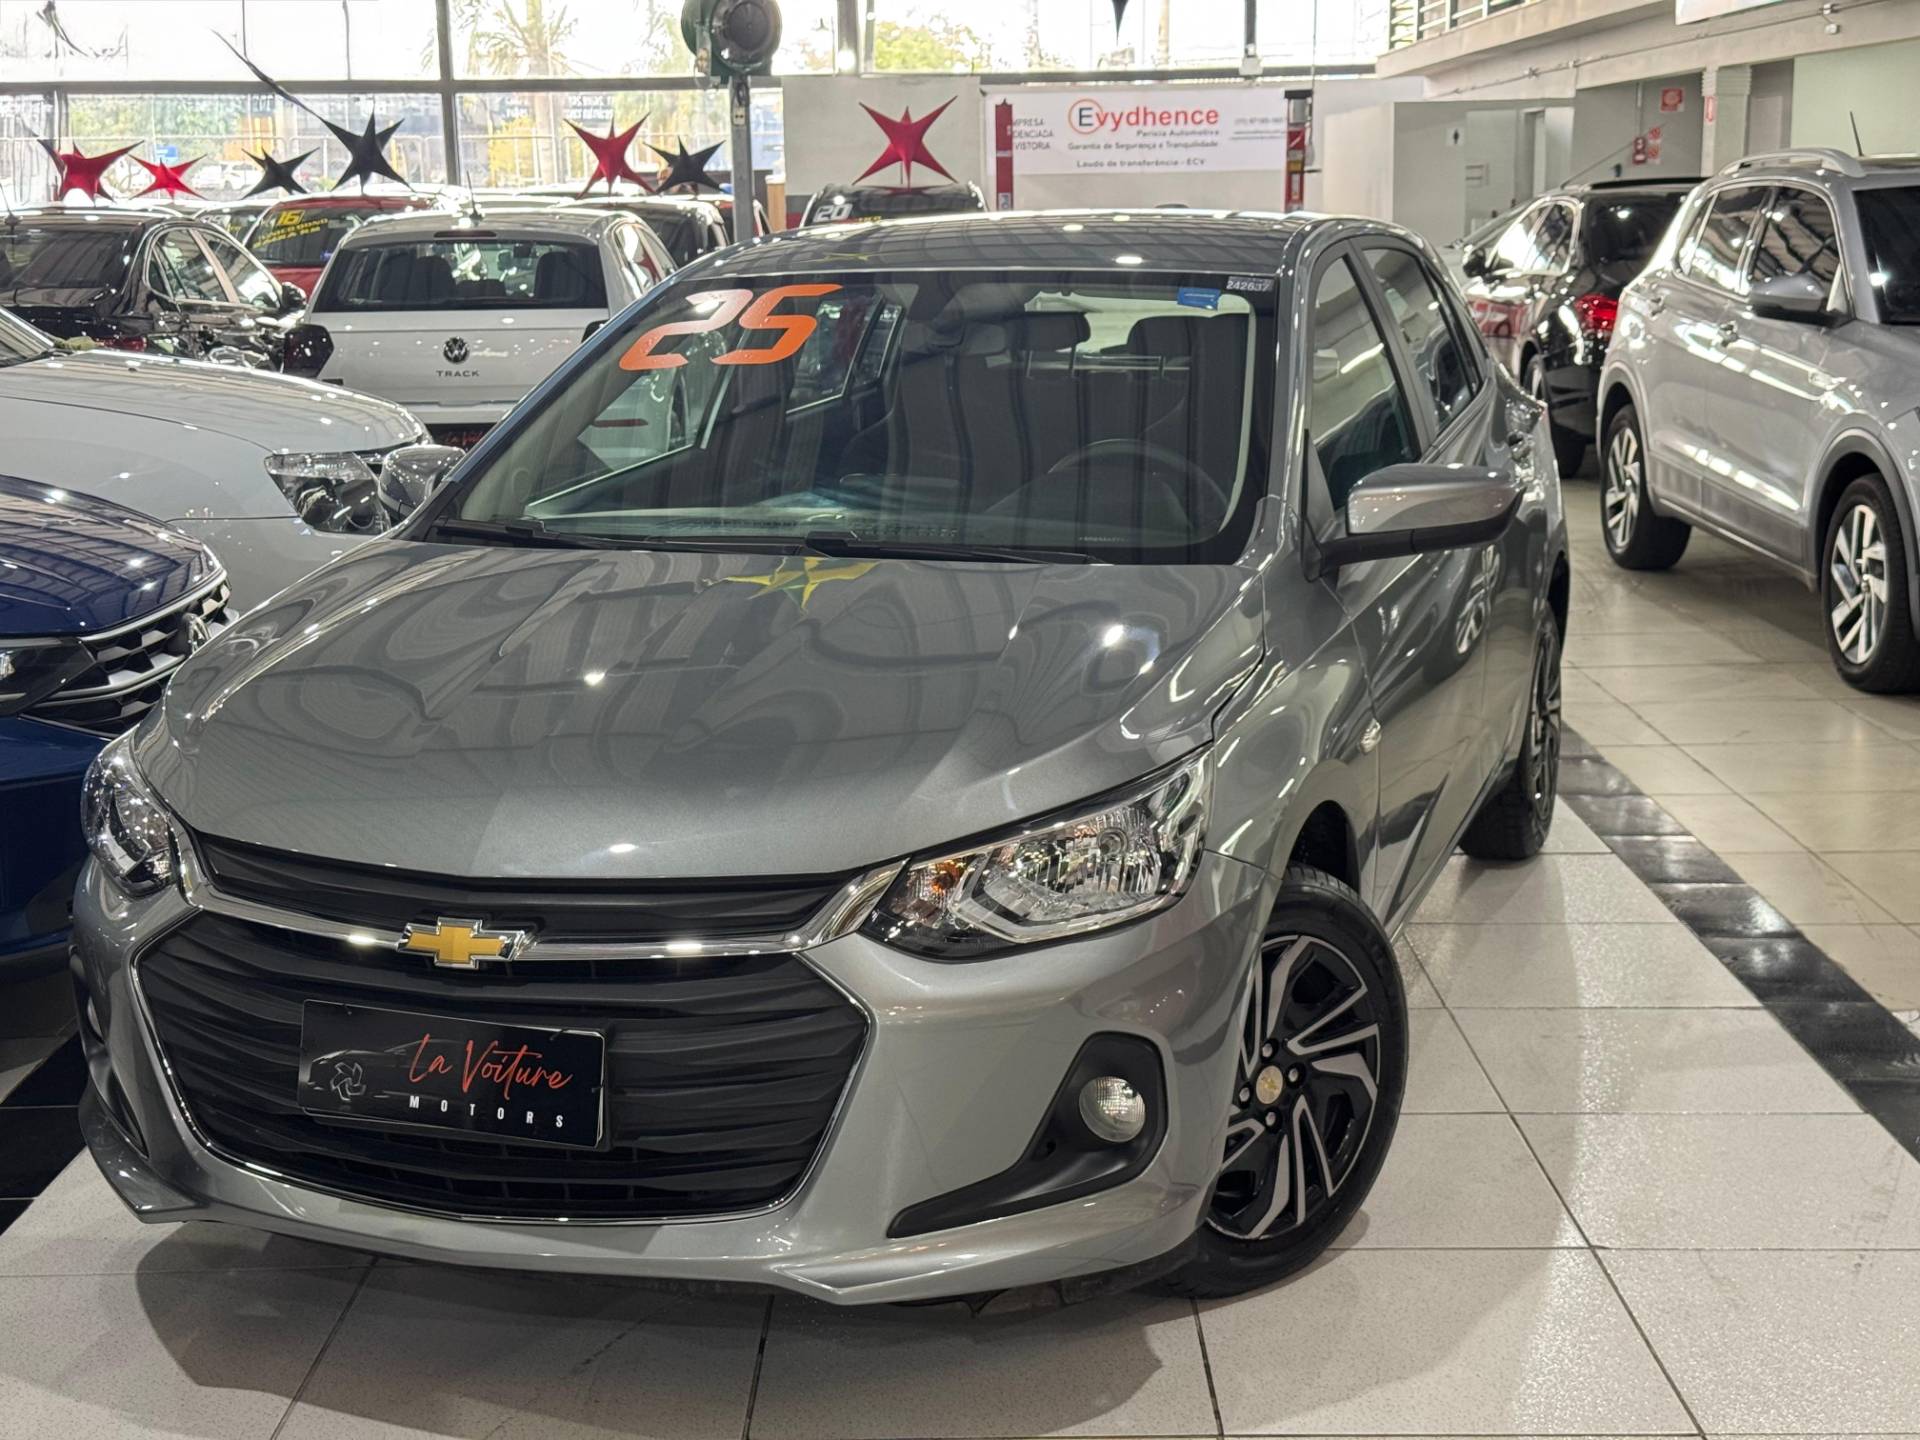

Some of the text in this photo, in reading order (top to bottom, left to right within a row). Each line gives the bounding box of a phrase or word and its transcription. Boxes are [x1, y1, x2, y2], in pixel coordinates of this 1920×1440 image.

[1078, 106, 1219, 133] Evydhence
[1168, 128, 1220, 138] Automotiva
[1015, 141, 1051, 150] VISTORIA
[1067, 142, 1101, 151] Garantia
[1103, 142, 1113, 150] de
[1115, 141, 1157, 153] Segurança
[1166, 140, 1219, 150] Tranquilidade
[1076, 159, 1104, 168] Laudo
[1107, 159, 1117, 168] de
[1119, 157, 1178, 168] transferência
[812, 203, 853, 223] 20
[619, 283, 843, 371] 25
[435, 369, 481, 378] TRACK
[408, 1033, 574, 1101] La Voiture
[408, 1095, 564, 1129] MOTORS
